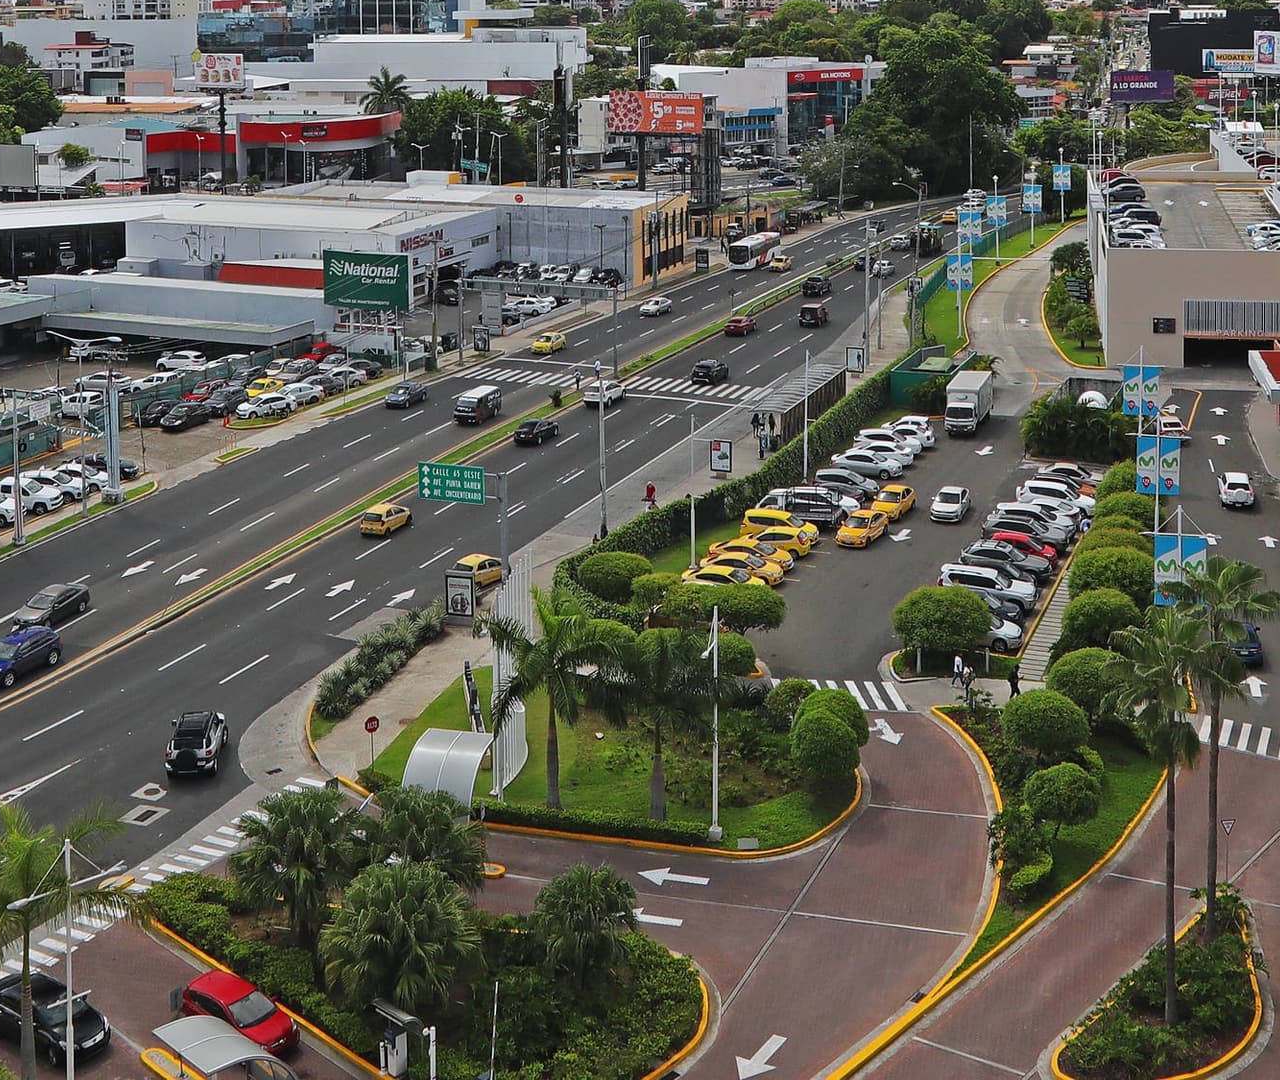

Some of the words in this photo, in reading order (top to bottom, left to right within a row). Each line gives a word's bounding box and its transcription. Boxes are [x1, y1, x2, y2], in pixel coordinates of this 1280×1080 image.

[1130, 81, 1158, 89] GRANDE
[400, 229, 444, 252] NISSAN
[343, 262, 400, 277] National
[1216, 329, 1264, 337] PARKING
[432, 468, 449, 477] CALLE
[464, 471, 481, 479] OESTE
[446, 480, 461, 488] PUNTA
[445, 490, 481, 500] CINCUENTENARIO
